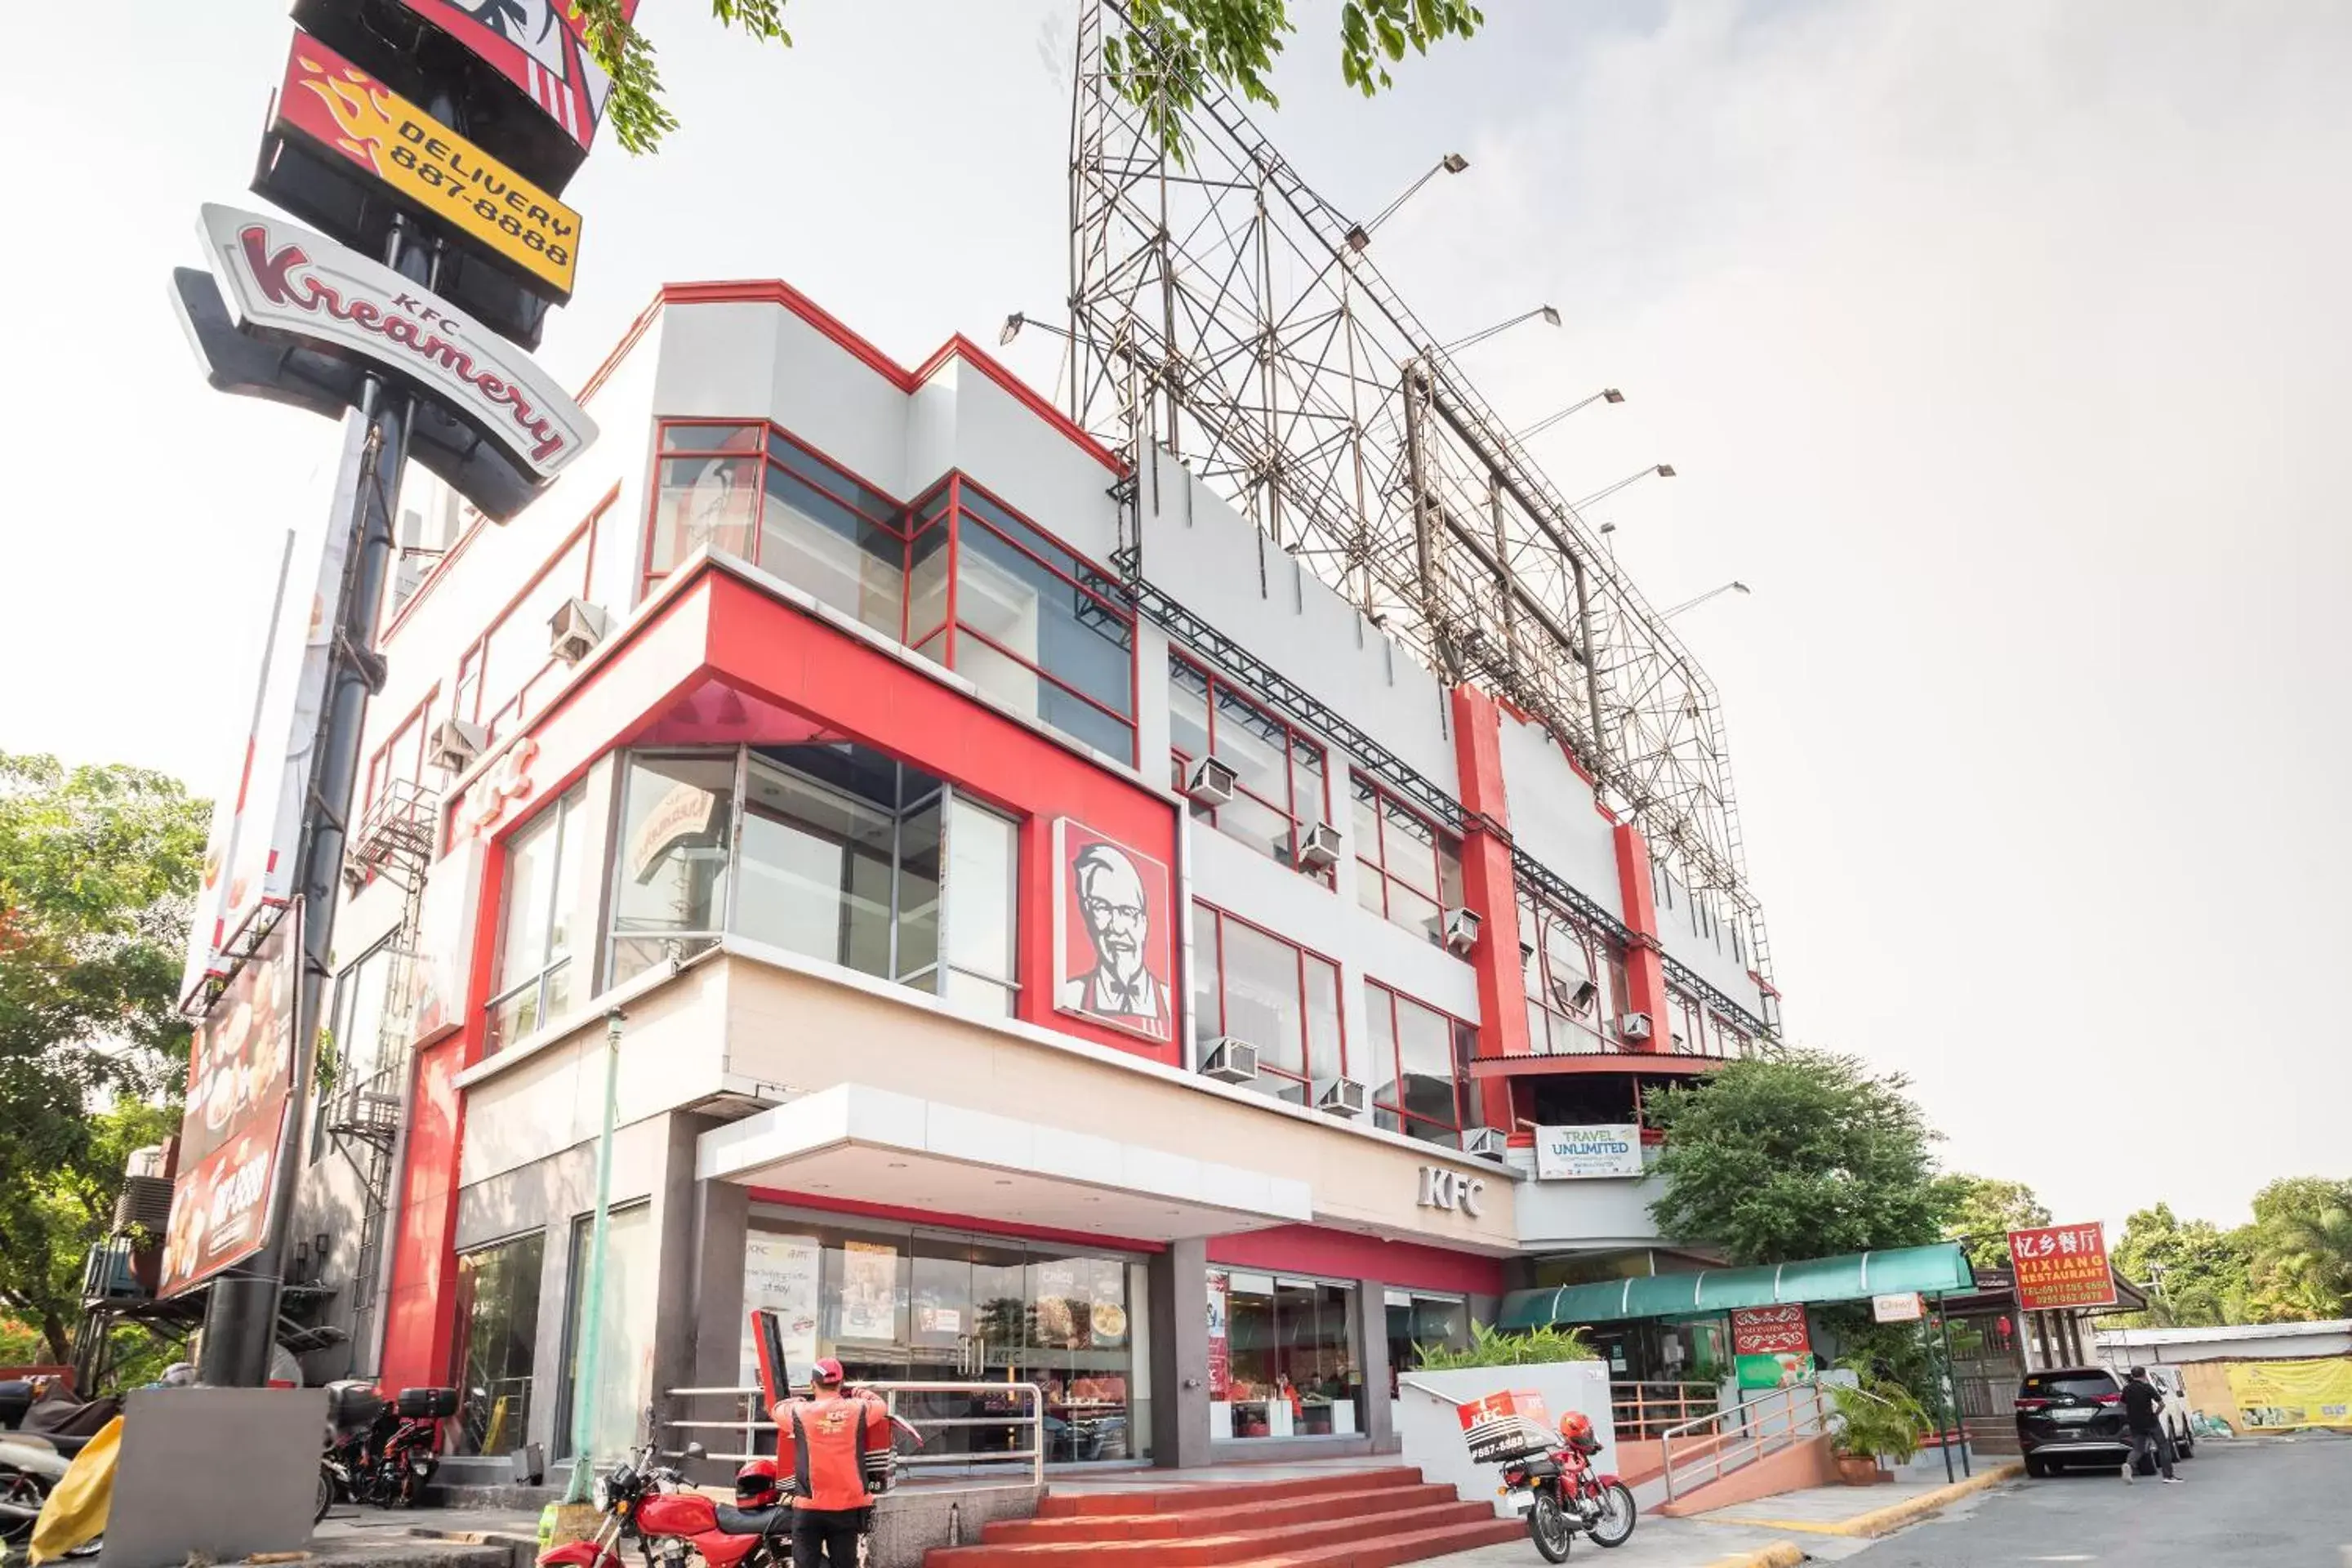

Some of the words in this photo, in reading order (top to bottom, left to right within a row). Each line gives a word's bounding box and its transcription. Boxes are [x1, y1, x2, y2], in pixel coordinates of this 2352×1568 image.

[399, 120, 571, 236] DELIVERY
[390, 145, 568, 266] 887-8888
[391, 292, 459, 336] KFC
[240, 226, 564, 463] Kreamery
[1552, 1142, 1629, 1155] UNLIMITED
[1563, 1129, 1615, 1143] TRAVEL
[1417, 1166, 1486, 1218] KFC
[2015, 1228, 2097, 1258] 忆乡餐厅
[2018, 1254, 2103, 1273] YIXIANG
[2020, 1267, 2104, 1284] RESTAURANT
[1471, 1406, 1502, 1427] KFC
